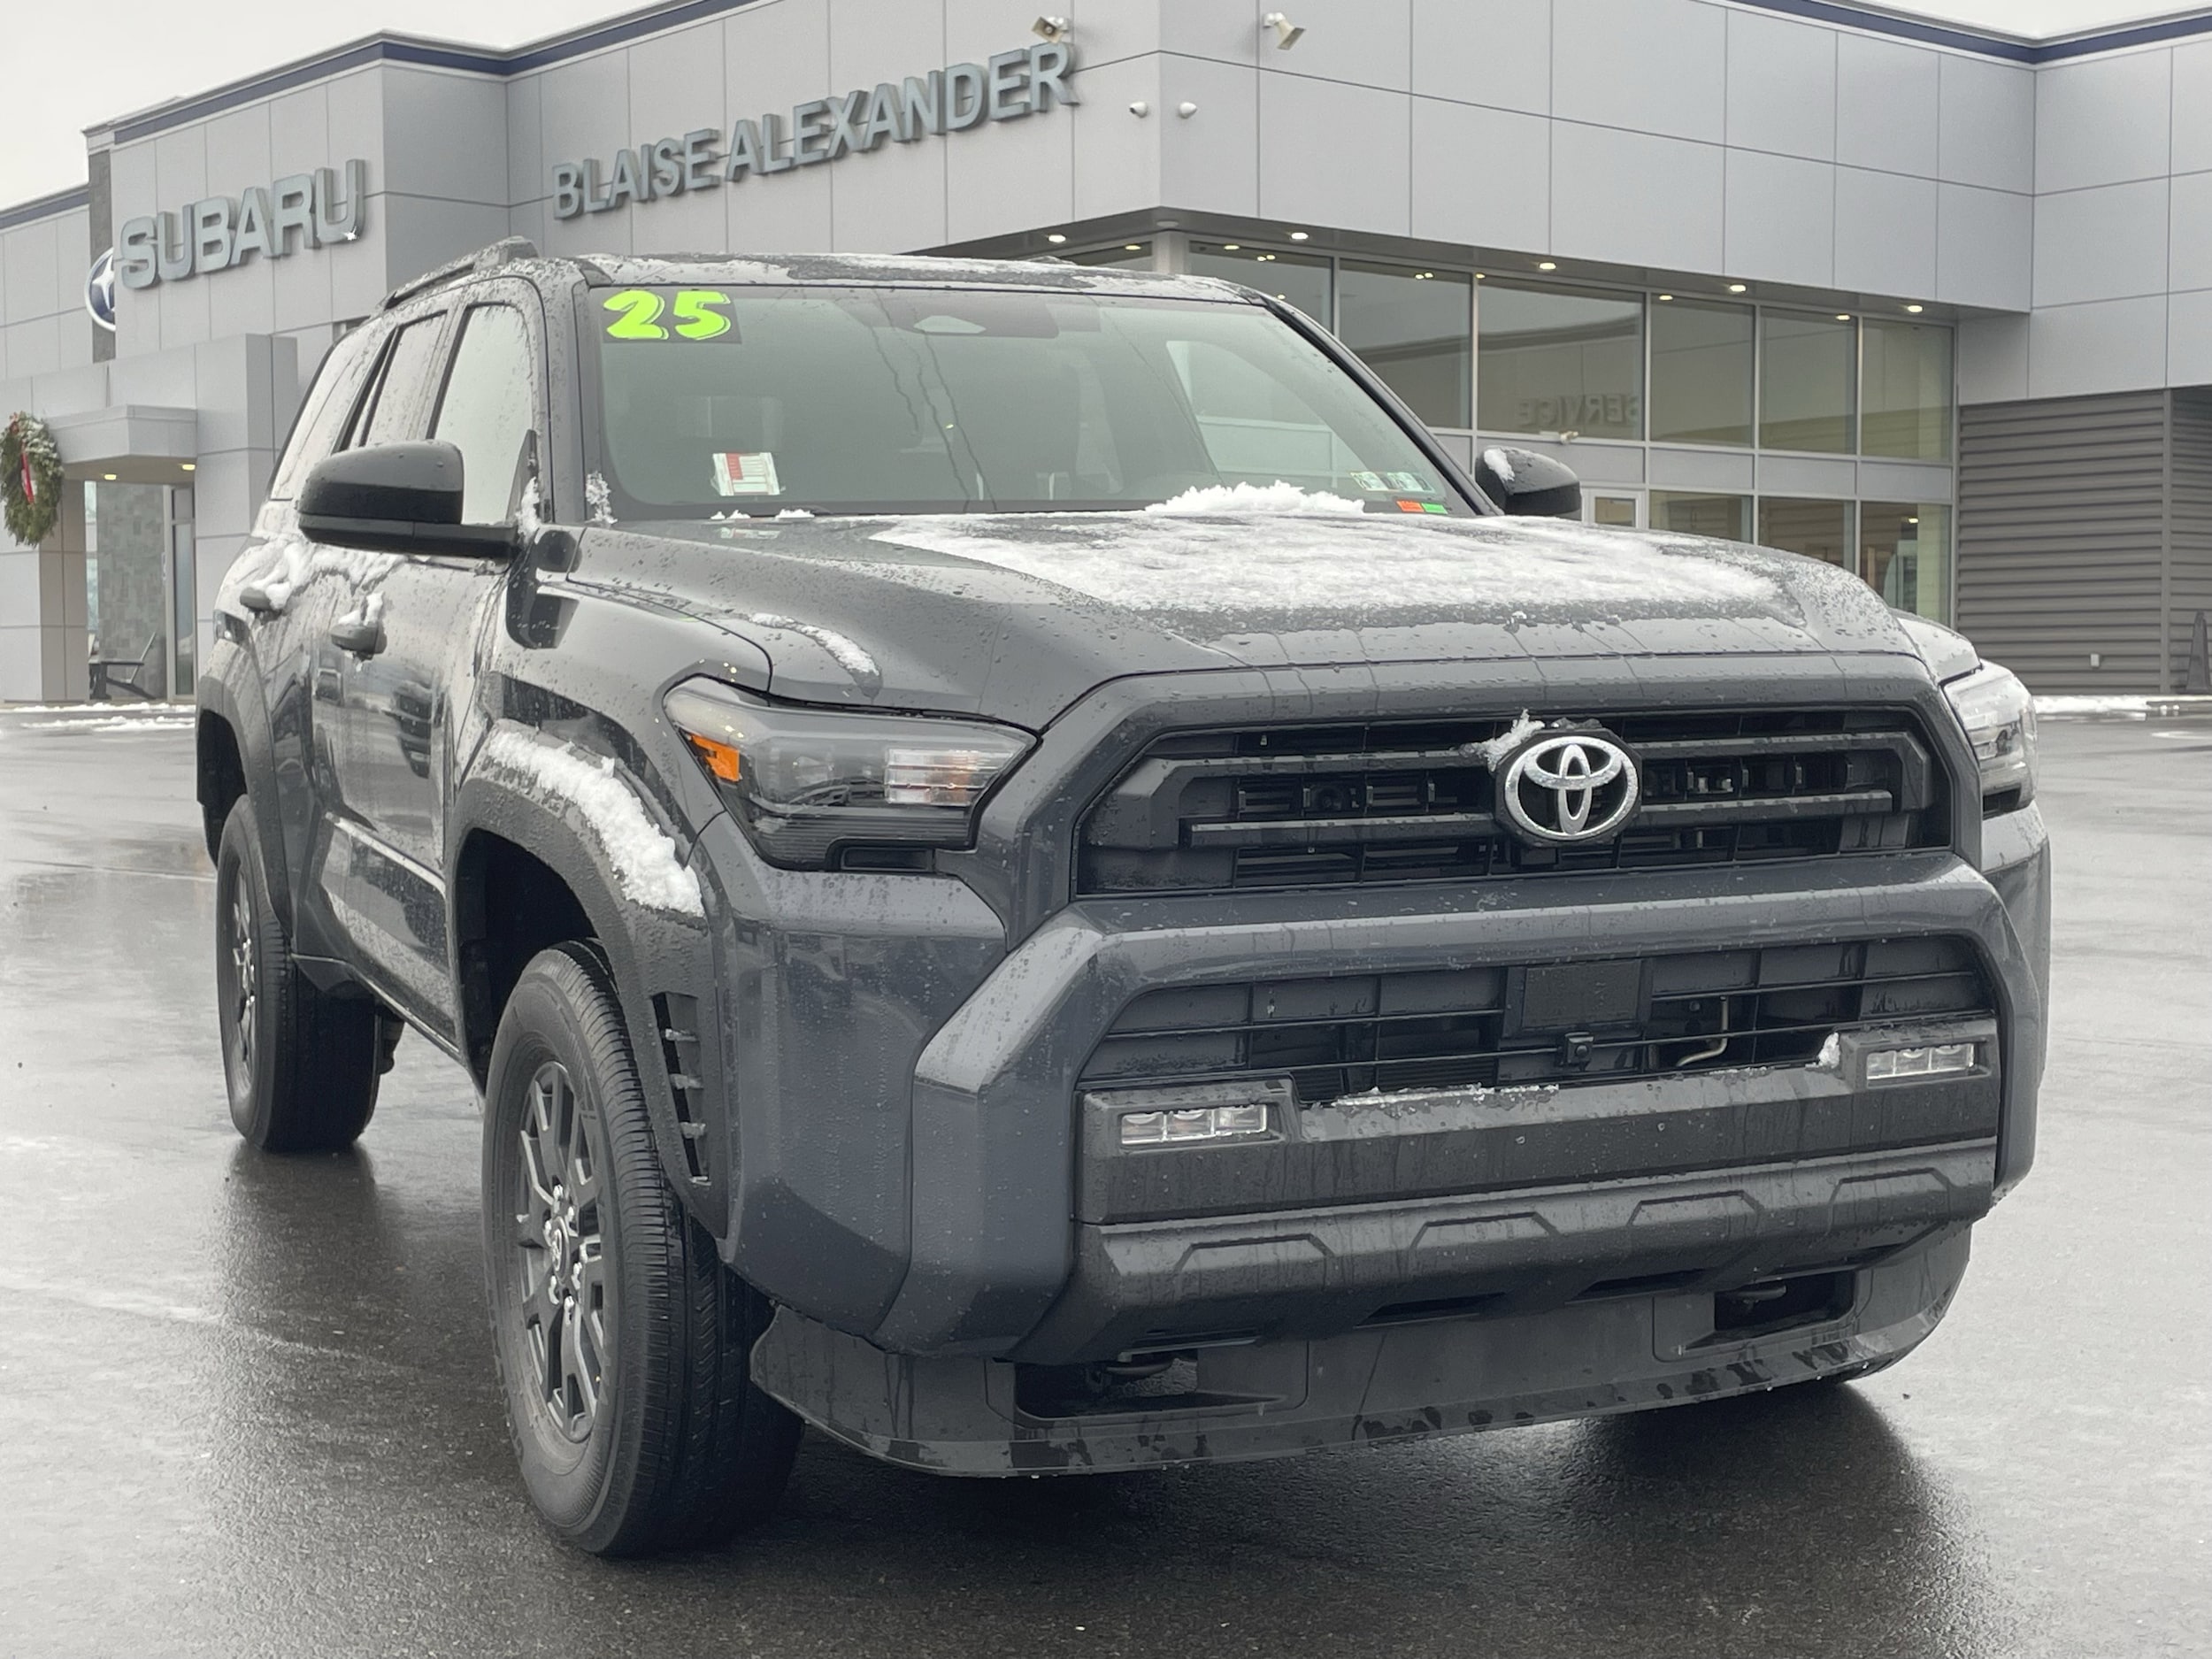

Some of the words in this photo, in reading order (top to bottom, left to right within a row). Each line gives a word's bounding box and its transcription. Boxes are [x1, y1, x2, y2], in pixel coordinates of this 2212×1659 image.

[553, 128, 719, 219] BLAISE
[725, 42, 1080, 182] ALEXANDER
[120, 158, 365, 289] SUBARU
[603, 289, 731, 341] 25
